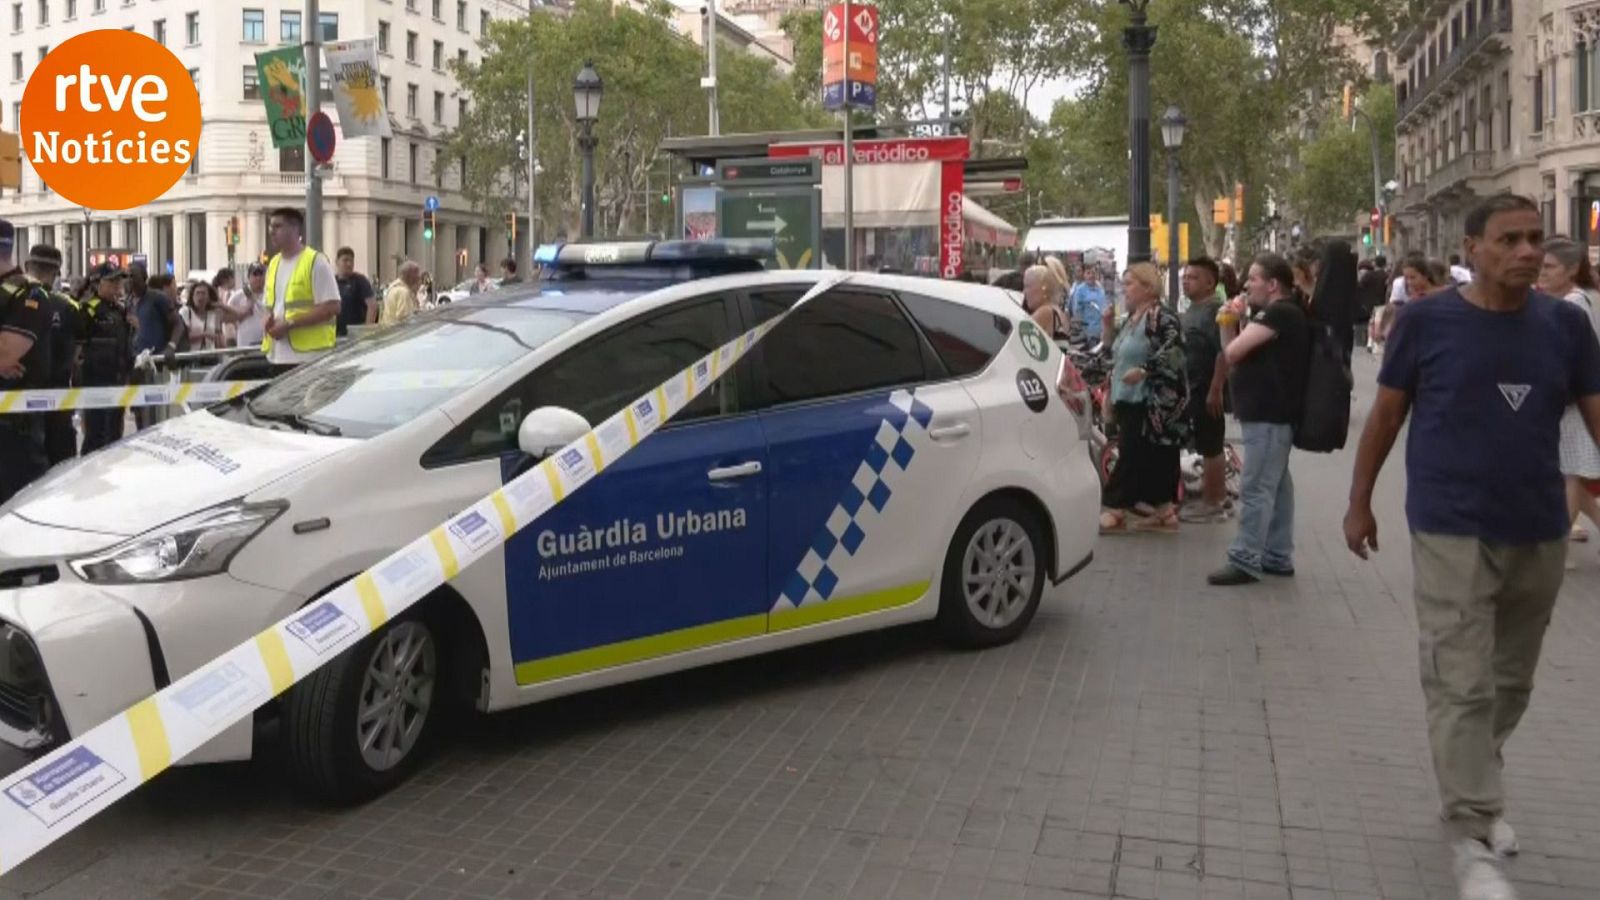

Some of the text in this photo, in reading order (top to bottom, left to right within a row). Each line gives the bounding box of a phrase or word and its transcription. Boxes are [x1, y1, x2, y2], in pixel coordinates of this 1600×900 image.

[852, 82, 862, 98] P
[826, 144, 929, 163] el eriódico
[944, 191, 962, 279] Periódico
[1020, 378, 1044, 397] 112
[536, 518, 647, 559] Guàrdia
[655, 507, 747, 540] Urbana
[537, 545, 685, 582] Ajuntament de Barcelona
